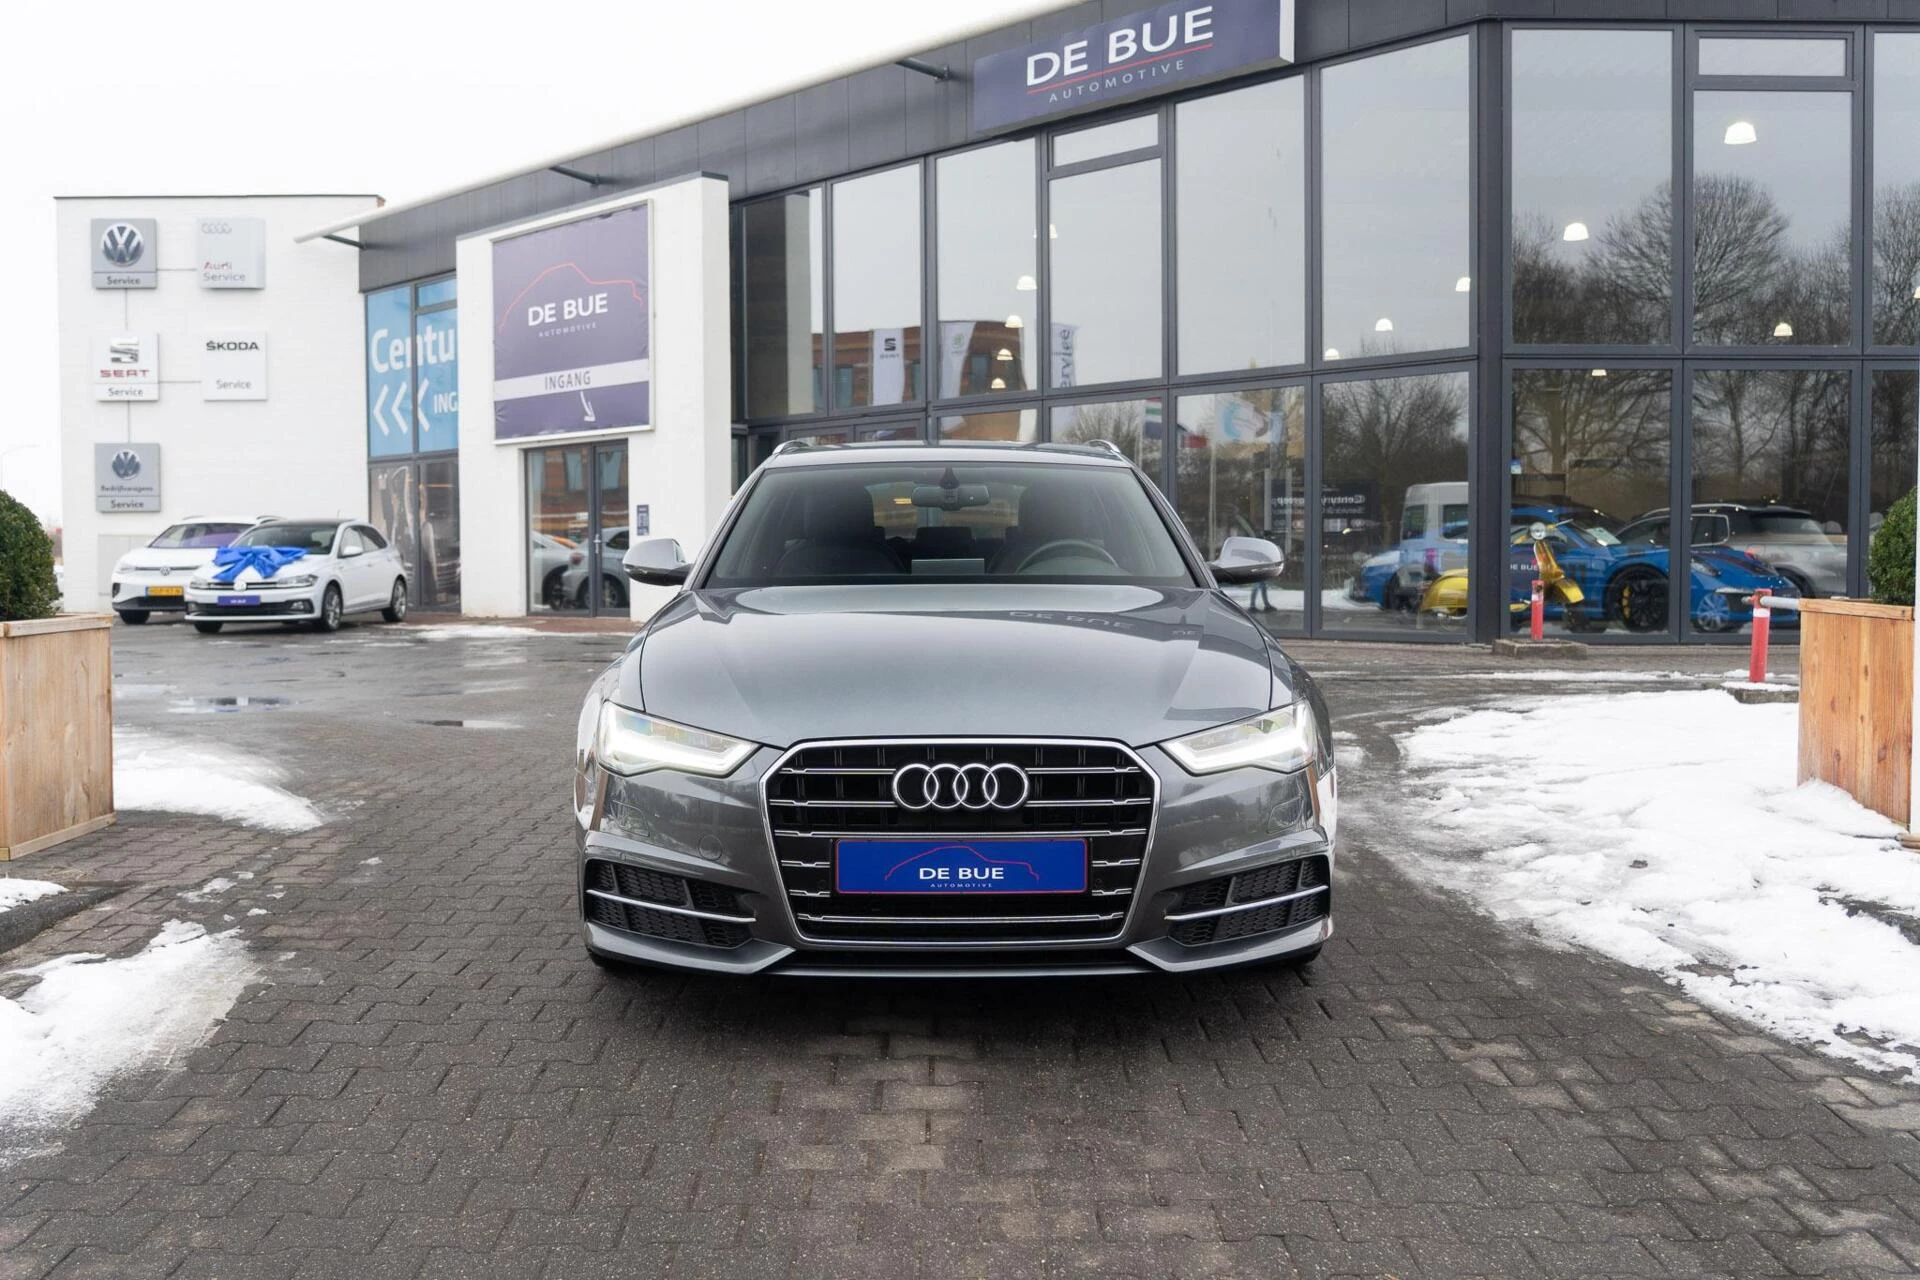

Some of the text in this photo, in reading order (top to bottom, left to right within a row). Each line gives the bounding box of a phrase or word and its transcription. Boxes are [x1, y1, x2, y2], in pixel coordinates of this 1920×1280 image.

[1027, 6, 1213, 86] DE BUE
[1049, 59, 1185, 103] AUTOMOTIVE
[202, 261, 233, 271] Audi
[106, 275, 141, 286] Service
[203, 272, 246, 282] Service
[528, 292, 608, 326] DE BUE
[538, 321, 597, 337] AUTOMOTIVE
[206, 340, 260, 351] ŠKODA
[371, 324, 456, 373] Centu
[100, 369, 149, 378] SEAT
[216, 380, 252, 390] Service
[544, 370, 591, 391] INGANG
[108, 387, 144, 397] Service
[110, 499, 144, 508] Service
[919, 867, 1004, 879] DE BUE
